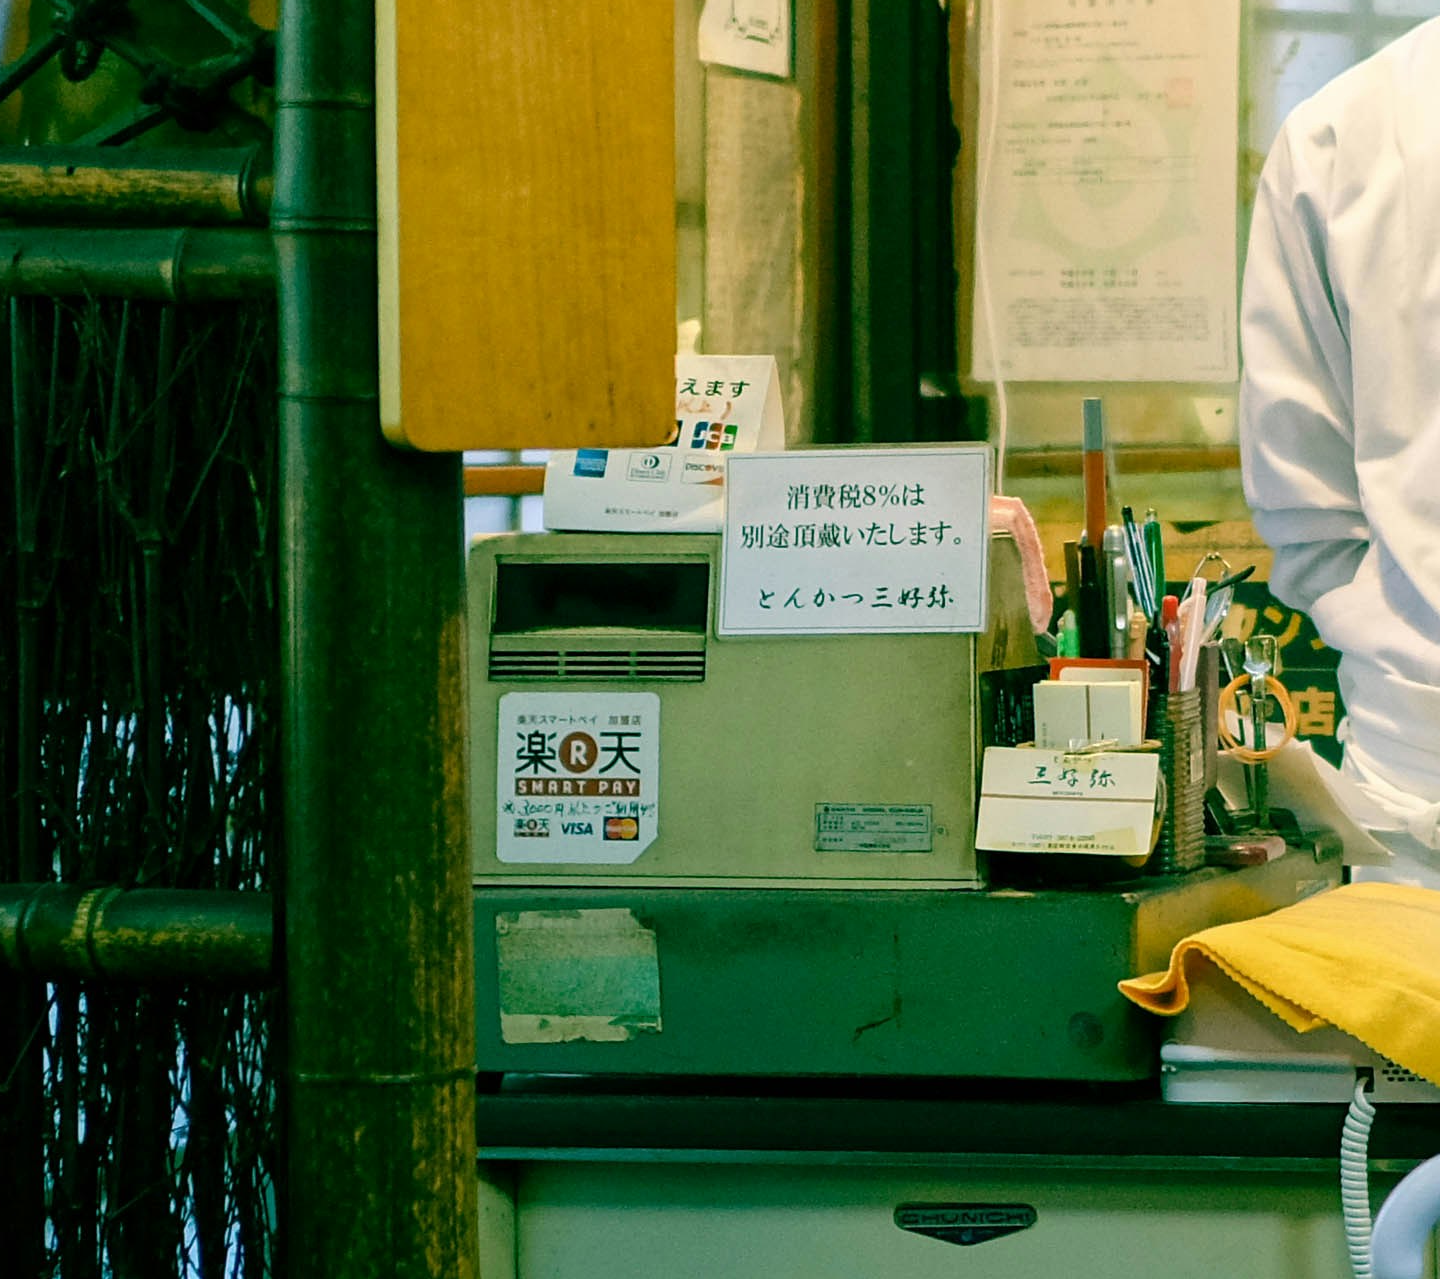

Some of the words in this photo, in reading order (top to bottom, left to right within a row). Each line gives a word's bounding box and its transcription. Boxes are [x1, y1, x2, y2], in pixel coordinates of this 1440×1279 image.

[679, 377, 751, 398] えます
[787, 483, 926, 511] 消費税8%は
[740, 520, 963, 550] 別途頂戴いたします。
[517, 715, 599, 726] 楽天スマートペイ
[518, 780, 587, 793] SMART
[599, 780, 638, 794] PAY
[561, 822, 594, 835] VISA
